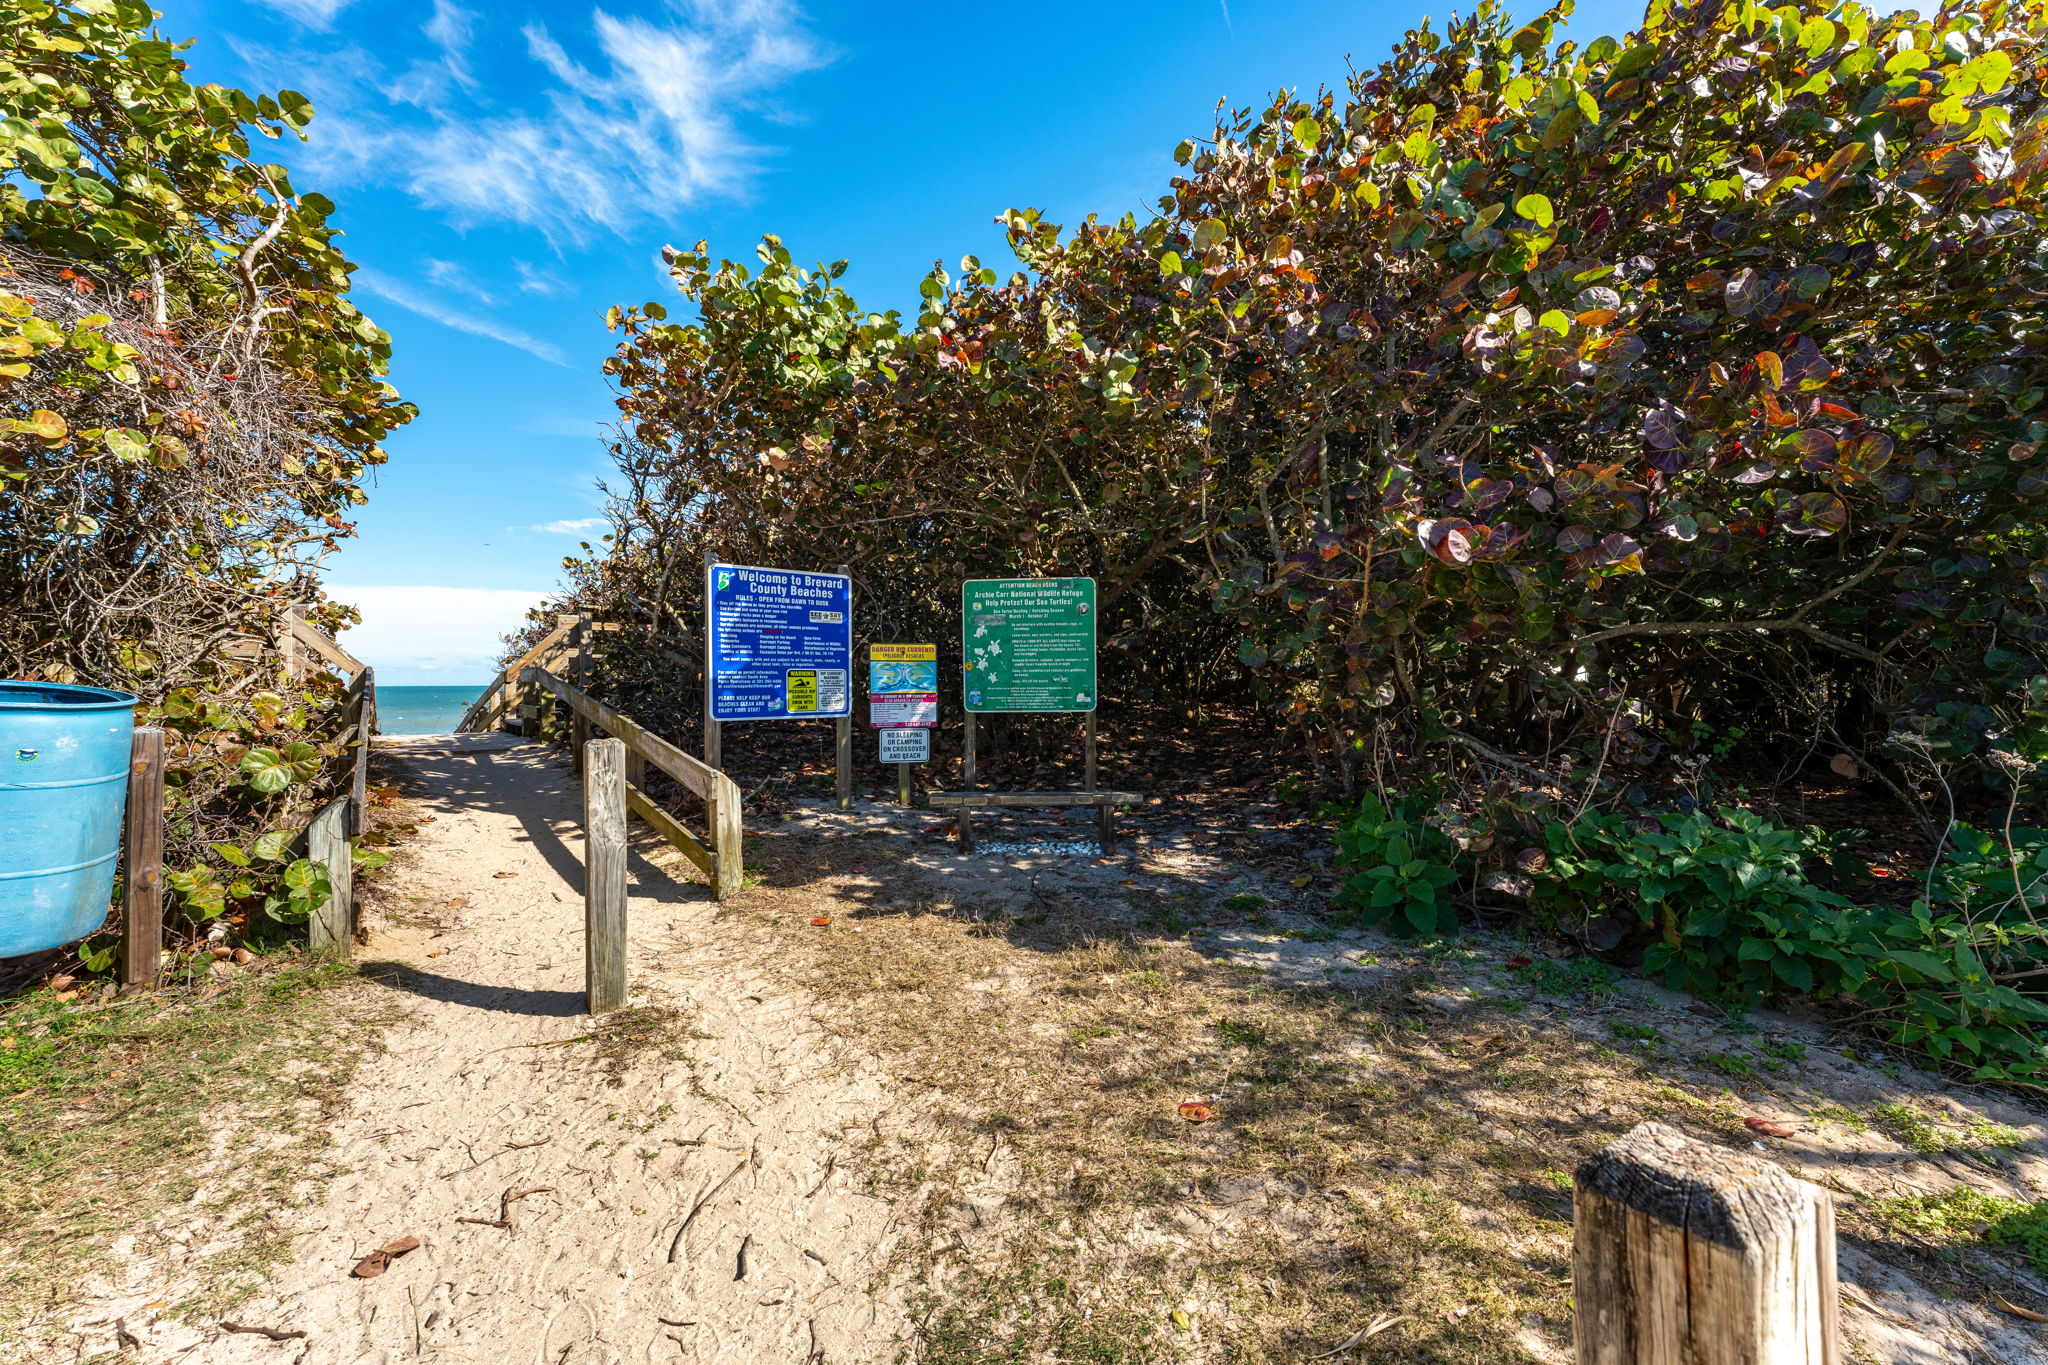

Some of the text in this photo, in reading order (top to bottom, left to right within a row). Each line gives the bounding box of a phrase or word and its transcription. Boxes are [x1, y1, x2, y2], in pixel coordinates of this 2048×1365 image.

[738, 570, 842, 589] Welcome to Brevard
[750, 582, 833, 598] County Beaches
